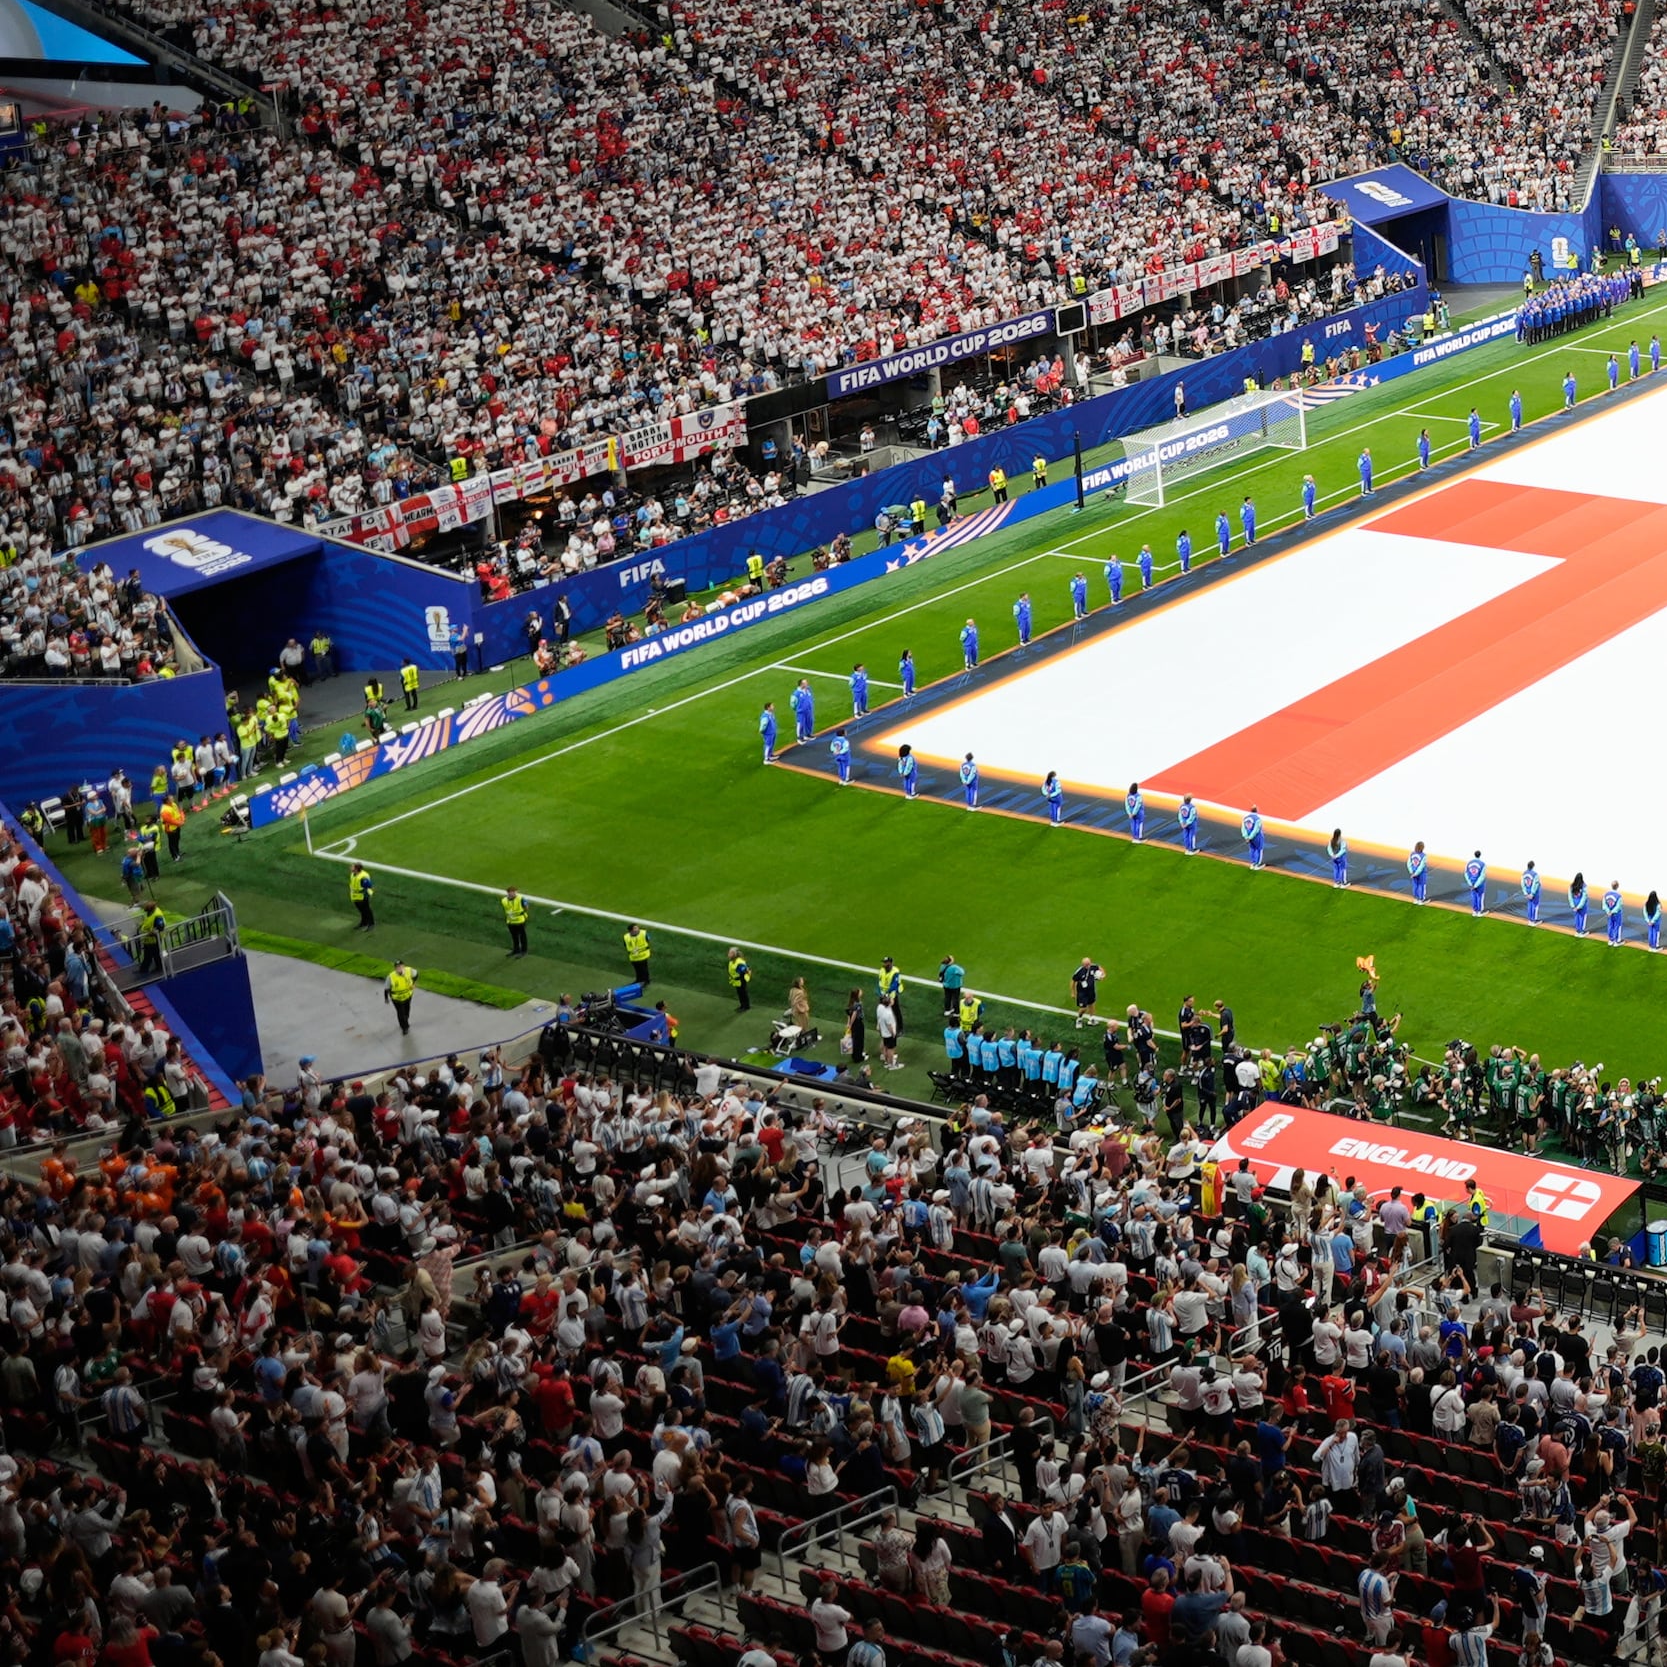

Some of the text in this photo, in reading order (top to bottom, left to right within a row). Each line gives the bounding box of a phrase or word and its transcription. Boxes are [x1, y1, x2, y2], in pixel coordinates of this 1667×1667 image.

[1324, 318, 1353, 339] FIFA
[1413, 327, 1491, 365] FIFA WORLD CUP
[840, 315, 1048, 393] FIFA WORLD CUP 2026
[628, 425, 661, 442] BARRY
[633, 429, 723, 465] PORTSMOUTH
[1081, 425, 1230, 491] FIFA WORLD CUP 2026
[619, 558, 666, 588] FIFA
[621, 577, 828, 670] FIFA WORLD CUP 2026
[1327, 1137, 1477, 1182] ENGLAND
